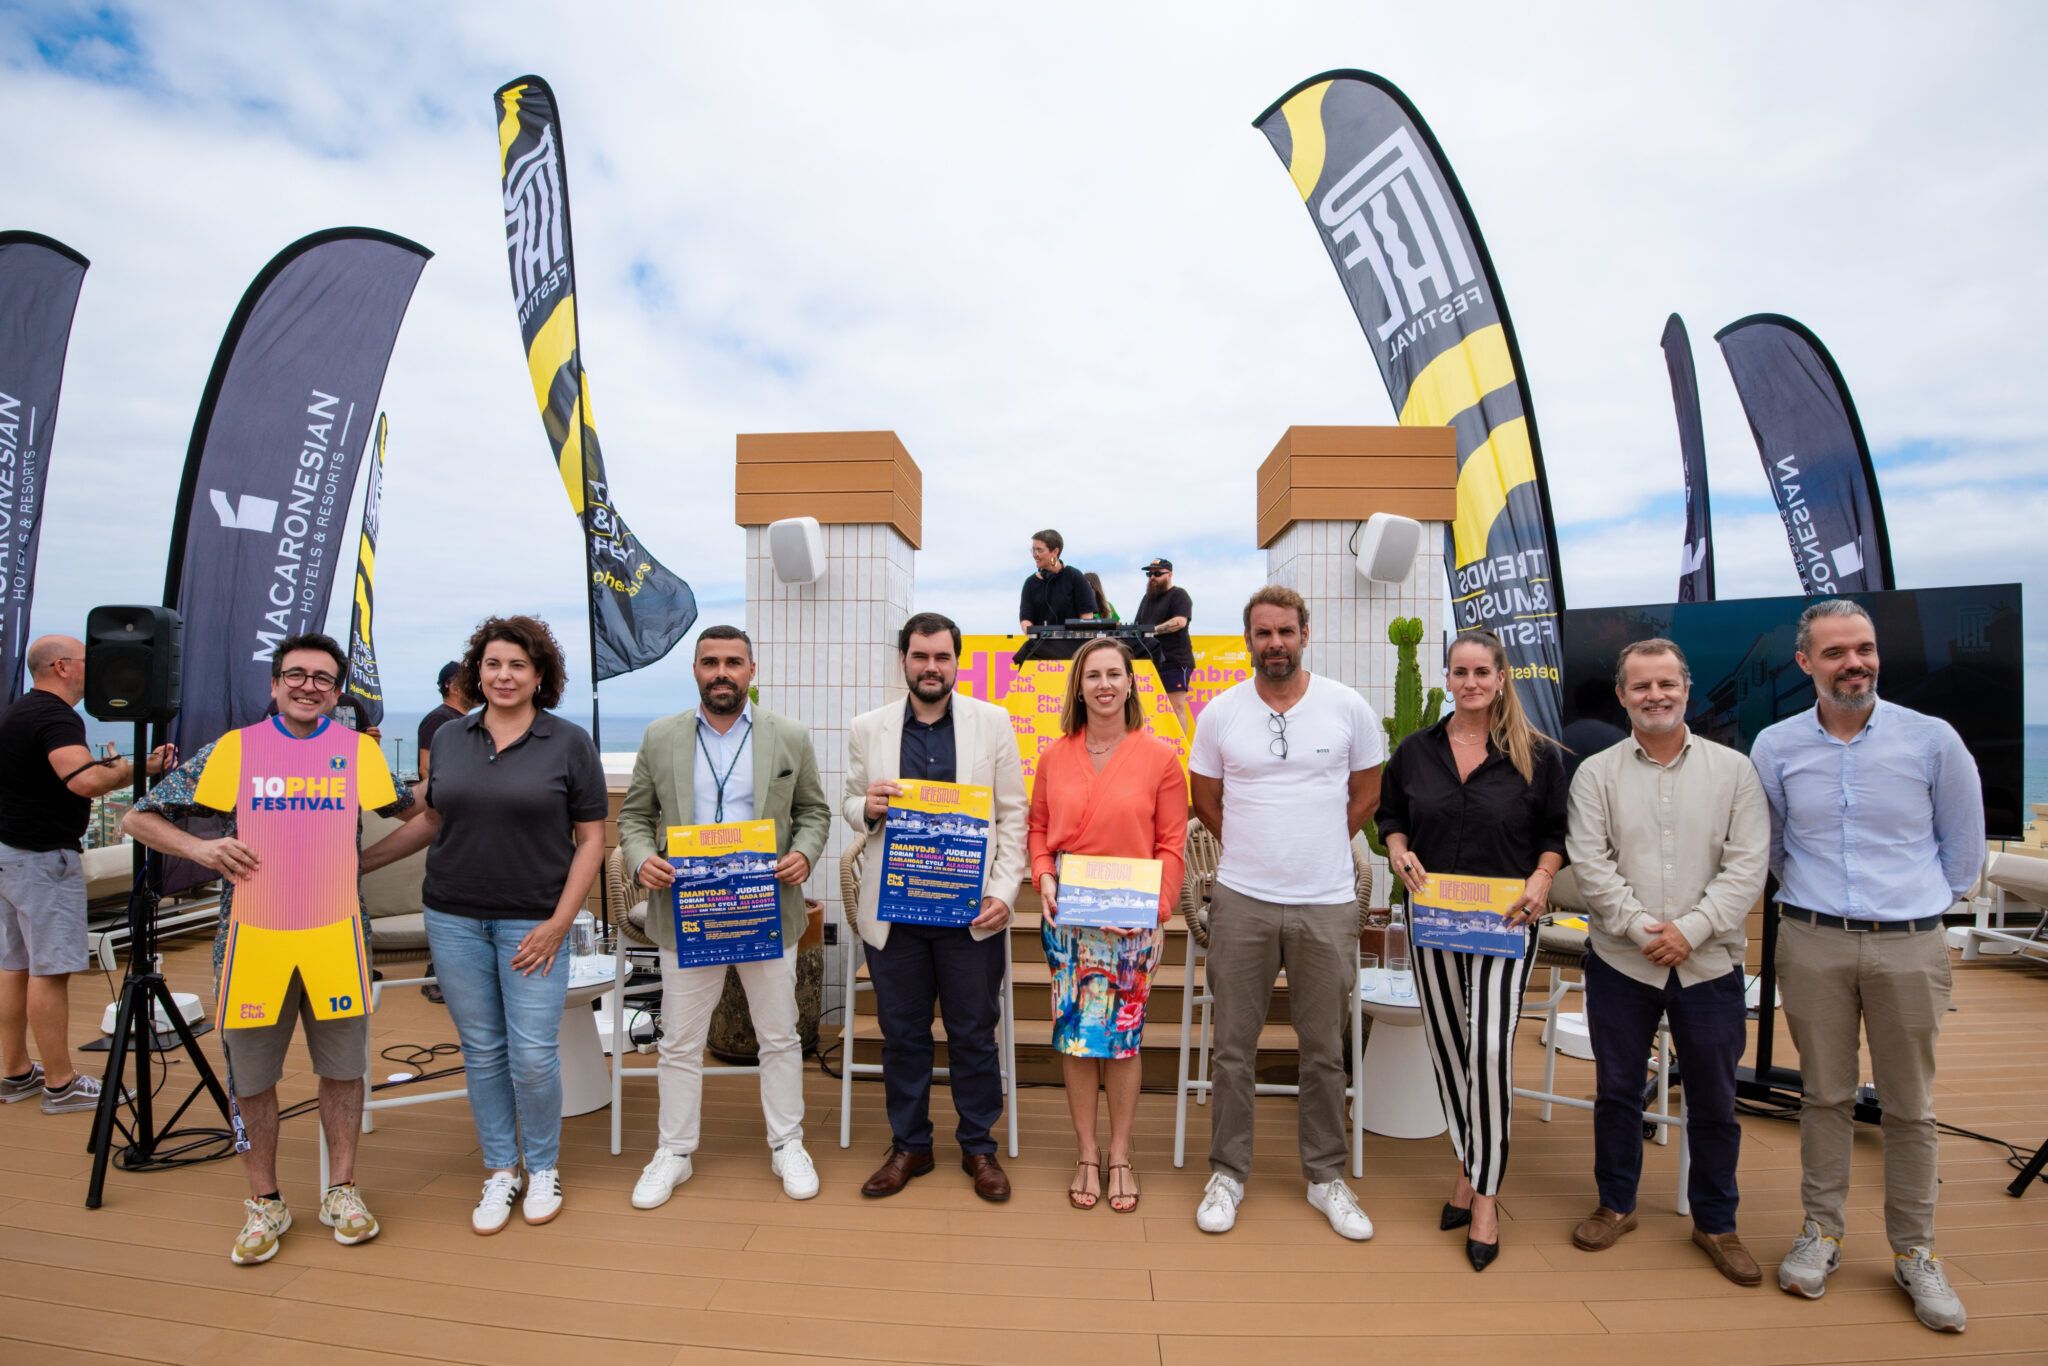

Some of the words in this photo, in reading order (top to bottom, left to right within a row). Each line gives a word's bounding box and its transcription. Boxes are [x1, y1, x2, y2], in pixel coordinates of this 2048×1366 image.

[20, 450, 35, 514] RESORTS
[316, 452, 345, 528] RESORTS
[252, 389, 340, 663] MACARONESIAN
[313, 531, 326, 543] &
[299, 547, 323, 613] HOTELS
[1037, 663, 1065, 672] Club
[252, 776, 347, 798] 10PHE
[251, 797, 345, 811] FESTIVAL
[889, 850, 914, 858] DORIAN
[890, 843, 936, 853] 2MANYDJS
[944, 848, 982, 859] JUDELINE
[679, 889, 727, 898] 2MANYDJS
[736, 884, 775, 895] JUDELINE
[241, 1003, 263, 1011] Phe
[329, 996, 352, 1012] 10
[240, 1010, 265, 1019] Club
